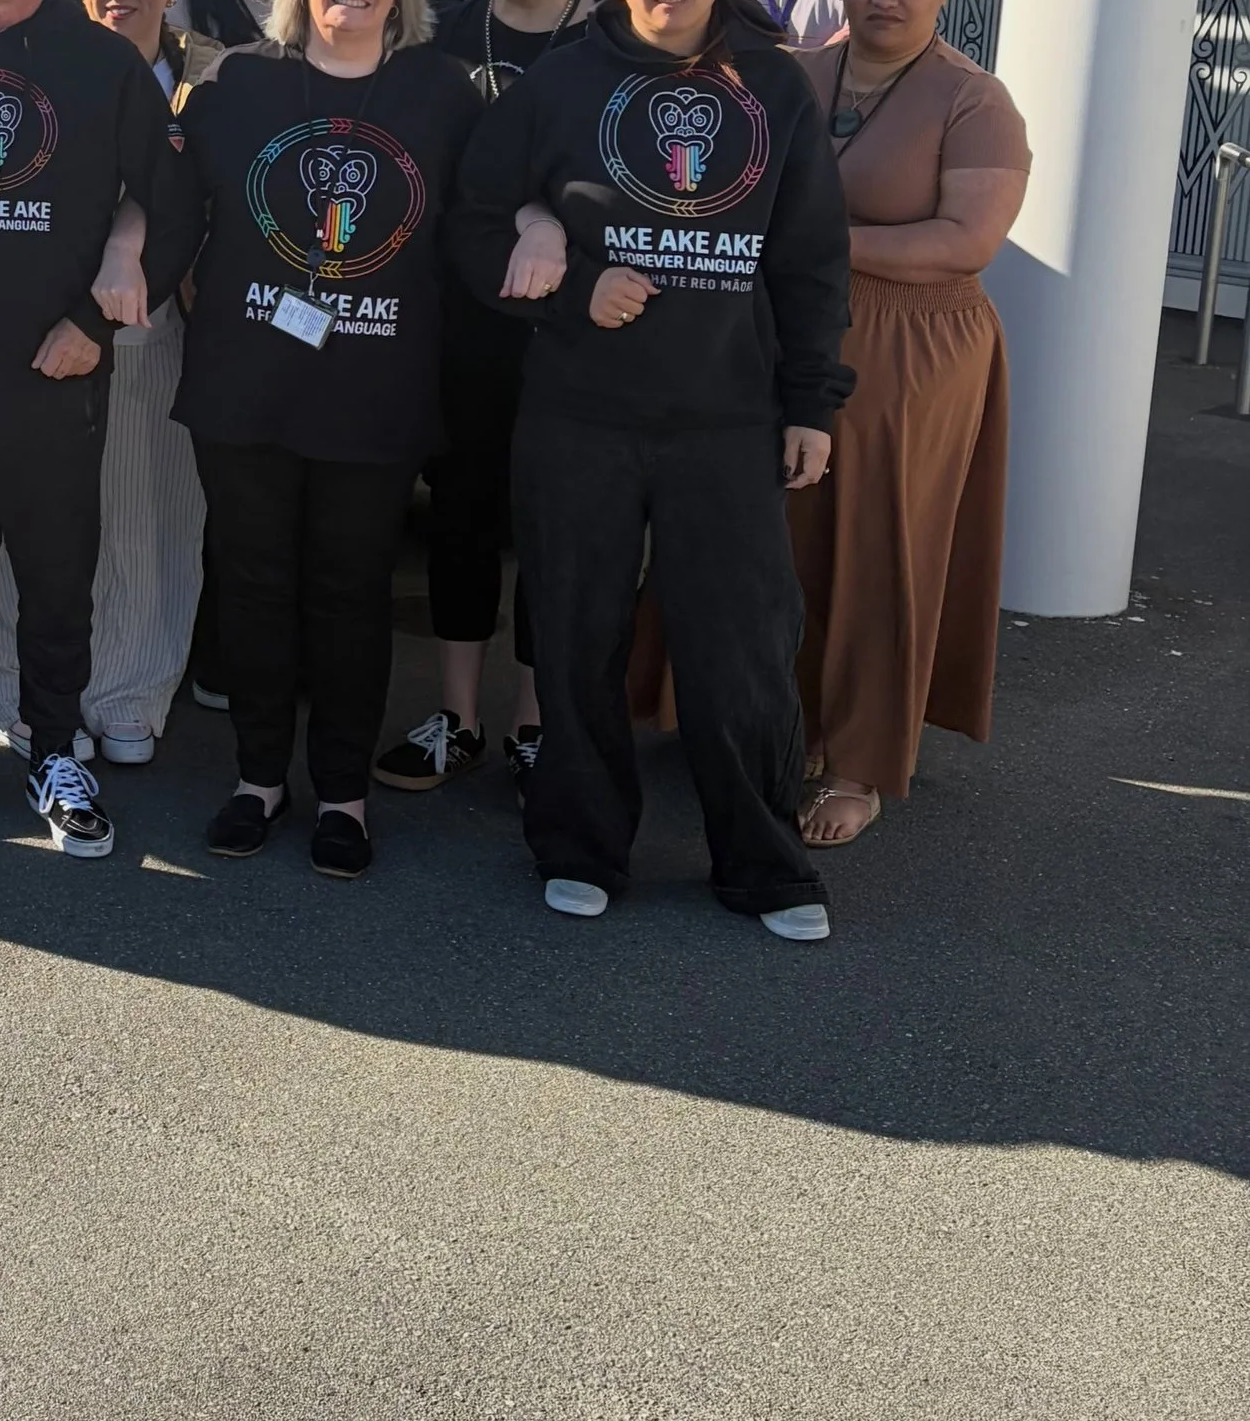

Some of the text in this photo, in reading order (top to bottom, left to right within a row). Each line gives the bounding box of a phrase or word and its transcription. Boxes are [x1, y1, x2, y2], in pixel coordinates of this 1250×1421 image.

[14, 201, 51, 219] AKE
[604, 226, 765, 258] AKE AKE AKE
[608, 250, 618, 263] A
[619, 251, 684, 269] FOREVER
[671, 275, 687, 288] TE
[690, 277, 716, 290] REO
[245, 282, 280, 307] AK
[319, 291, 353, 318] KE
[356, 296, 400, 320] AKE
[245, 307, 255, 320] A
[333, 320, 397, 337] ANGUAGE
